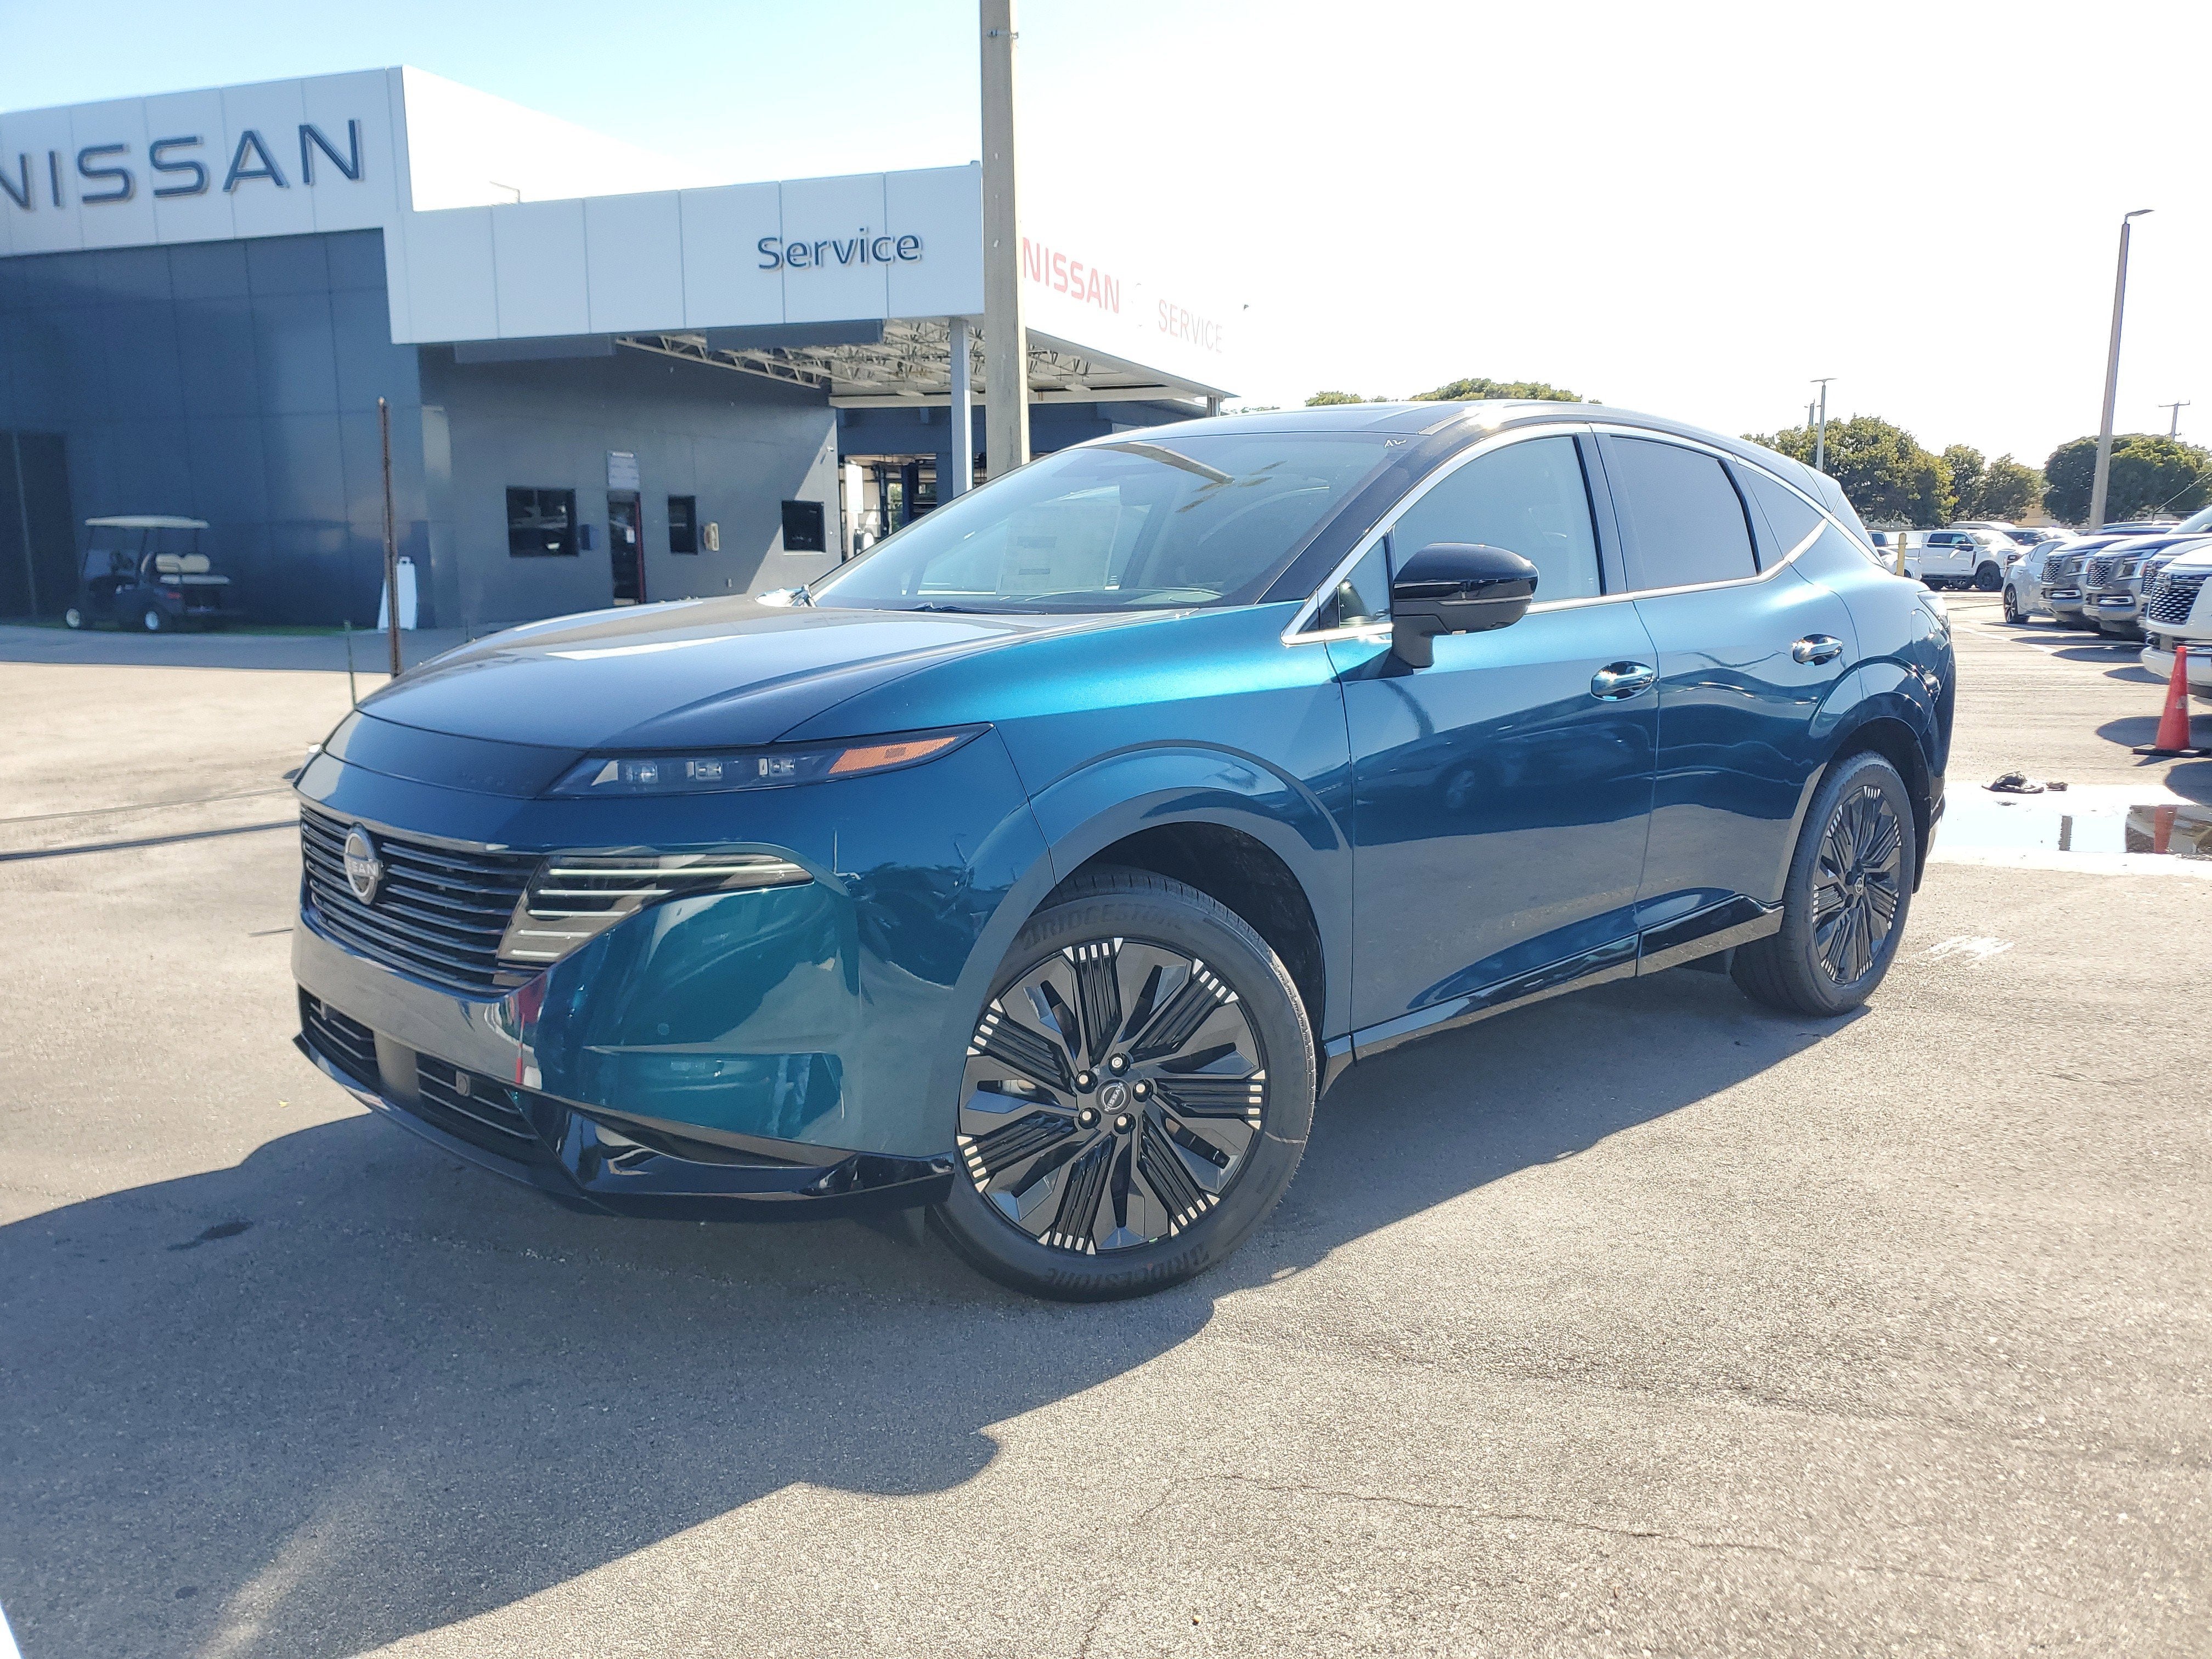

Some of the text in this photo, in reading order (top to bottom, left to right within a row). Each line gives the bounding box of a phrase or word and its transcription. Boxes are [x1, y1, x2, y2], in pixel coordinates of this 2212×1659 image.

[757, 228, 922, 269] Service
[1023, 237, 1223, 353] NISSAN SERVICE
[1104, 1082, 1123, 1112] NISSAN
